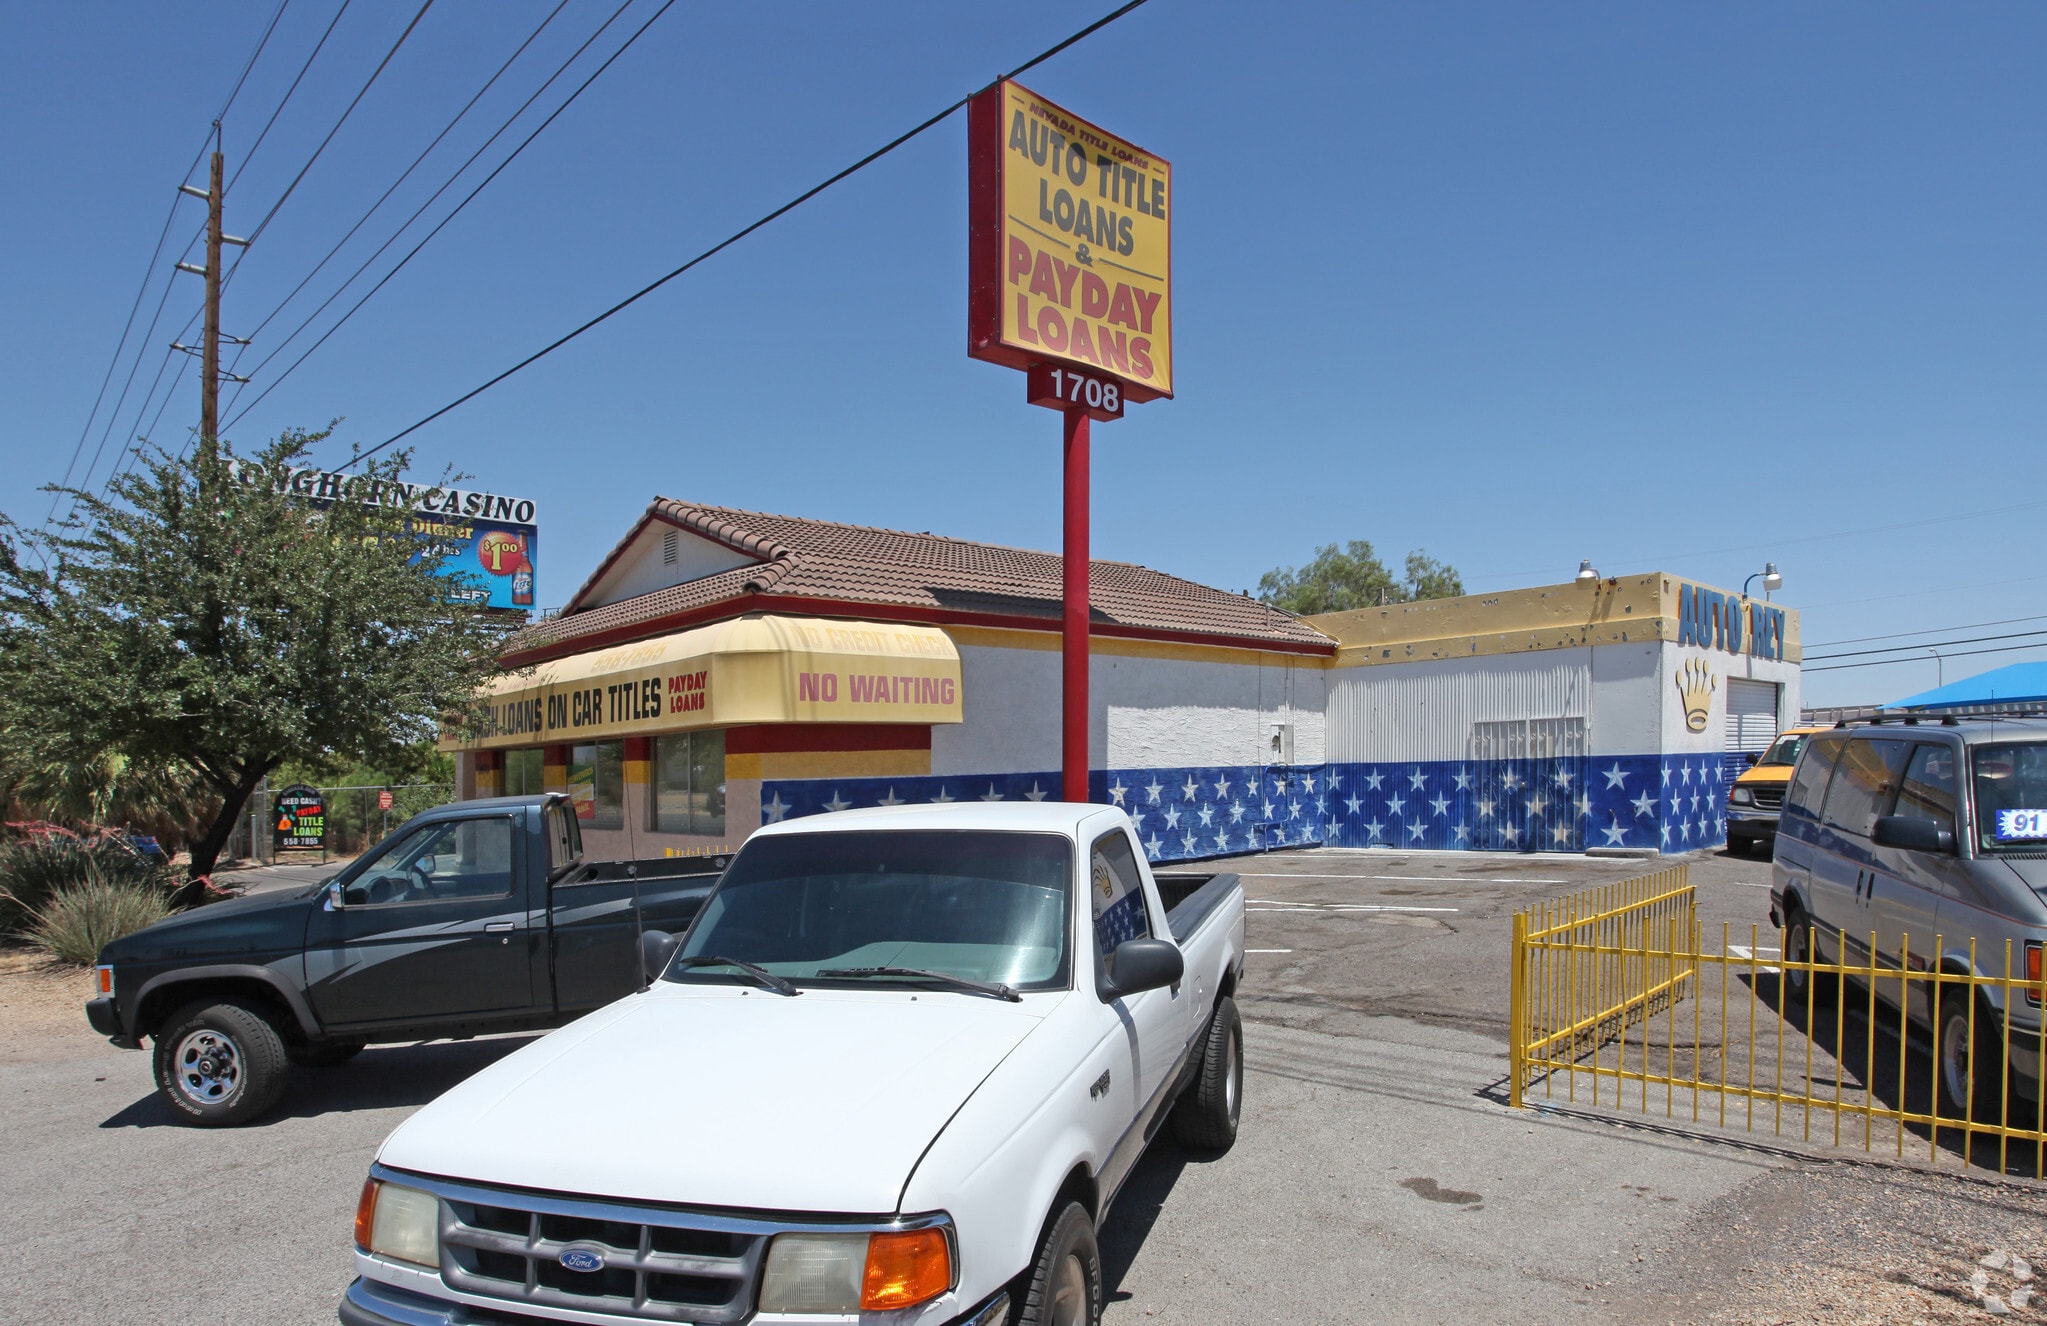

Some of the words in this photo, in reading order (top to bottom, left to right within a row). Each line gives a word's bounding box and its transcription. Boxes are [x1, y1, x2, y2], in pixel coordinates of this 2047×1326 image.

[1029, 102, 1075, 135] NEVADA
[1079, 131, 1108, 151] TITLE
[1112, 142, 1149, 170] LOANS
[1009, 109, 1087, 186] AUTO
[1097, 154, 1165, 220] TITLE
[1039, 178, 1133, 257] LOANS
[1075, 243, 1093, 268] &
[1008, 233, 1161, 335] PAYDAY
[1017, 292, 1154, 380] LOANS
[1050, 368, 1118, 412] 1708
[423, 487, 535, 523] CASINO
[1678, 583, 1742, 653] AUTO
[1751, 603, 1785, 661] REY
[788, 625, 823, 648] NO
[825, 627, 888, 652] CREDIT
[894, 633, 955, 657] CHECK
[668, 671, 708, 694] PAYDAY
[799, 672, 837, 702] NO
[848, 674, 955, 705] WAITING
[502, 697, 542, 737] LOANS
[548, 693, 567, 730] ON
[573, 688, 602, 727] CAR
[608, 677, 661, 724] TITLES
[670, 692, 705, 714] LOANS
[296, 806, 321, 816] PAYDAY
[298, 817, 323, 825] TITLE
[2013, 813, 2039, 832] 91
[294, 827, 322, 836] LOANS
